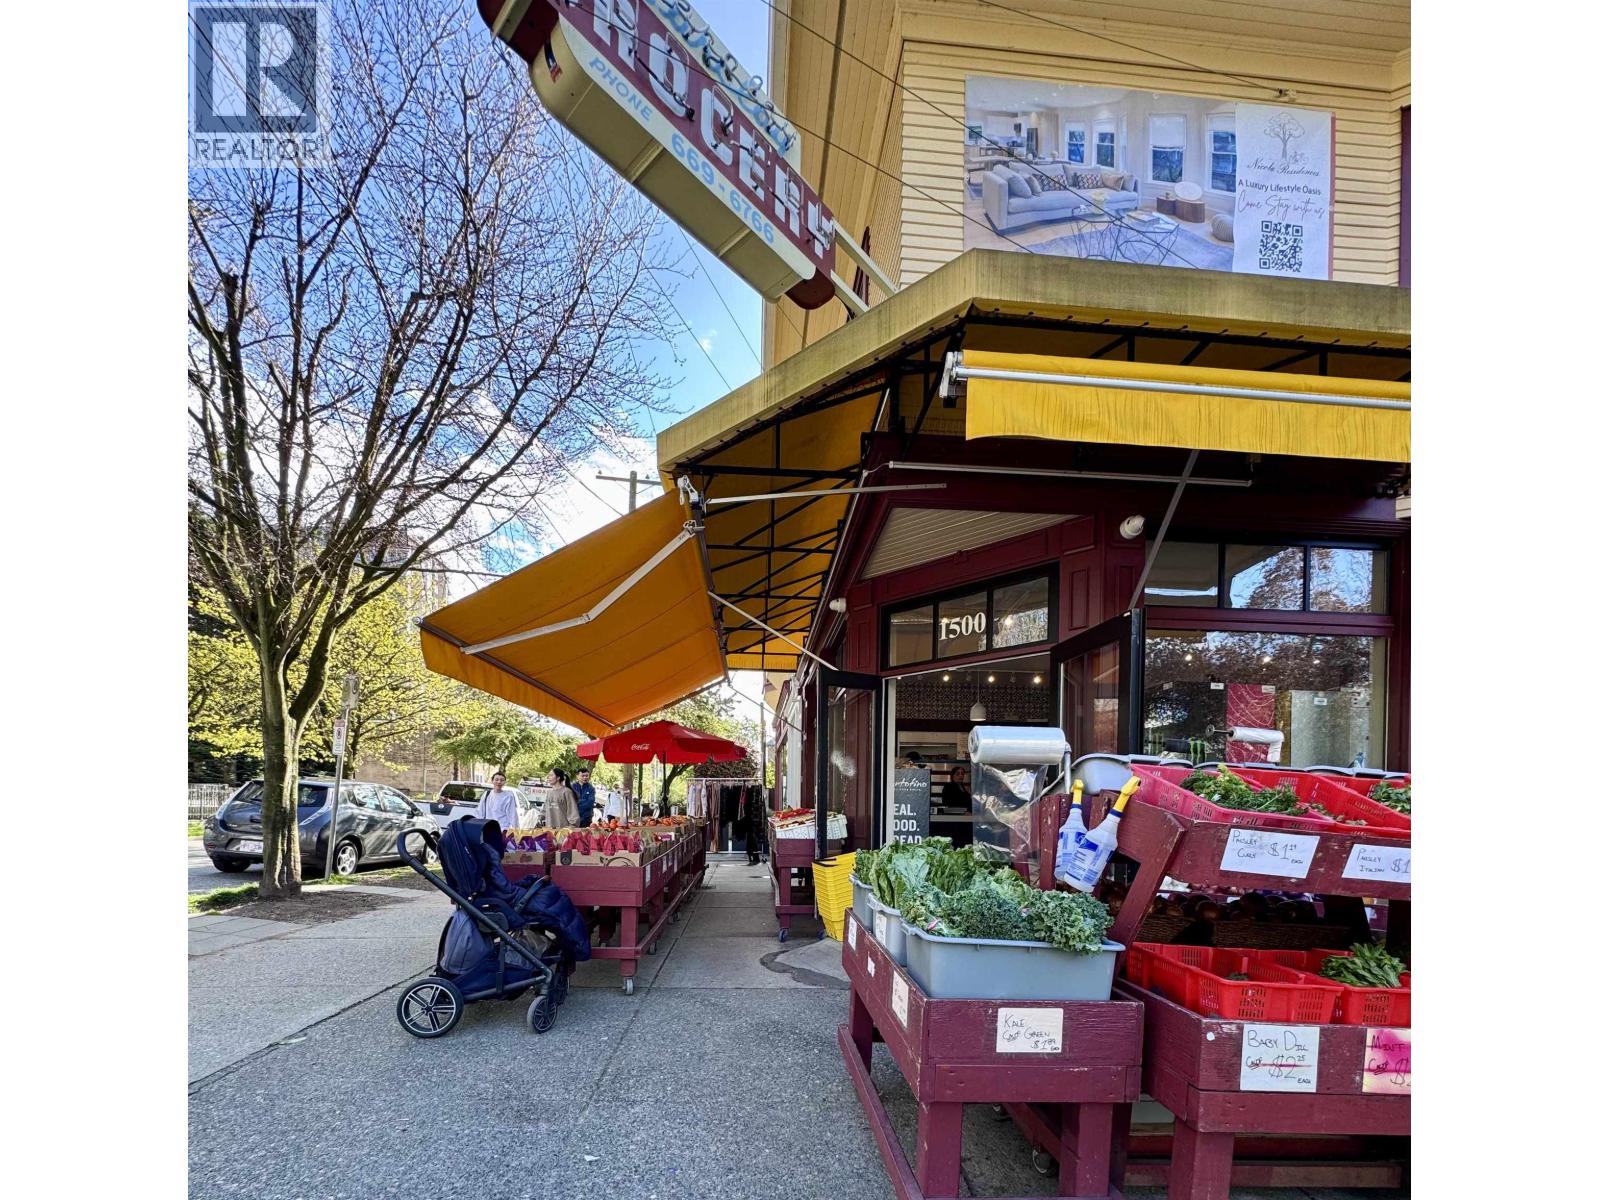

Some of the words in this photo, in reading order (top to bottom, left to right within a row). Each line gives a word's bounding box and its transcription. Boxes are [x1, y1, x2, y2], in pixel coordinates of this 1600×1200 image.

[589, 57, 653, 122] PHONE
[570, 0, 836, 259] ROCERY
[1238, 179, 1244, 187] A
[1245, 179, 1269, 193] Luxury
[1270, 184, 1302, 193] Lifestyle
[1302, 185, 1322, 196] Oasis
[1265, 194, 1291, 222] Stay
[938, 612, 987, 641] 1500
[894, 803, 917, 816] EAL.
[894, 819, 920, 832] OOD.
[894, 834, 922, 845] EAD
[1247, 1029, 1279, 1048] BABY
[1370, 1035, 1404, 1051] MINT
